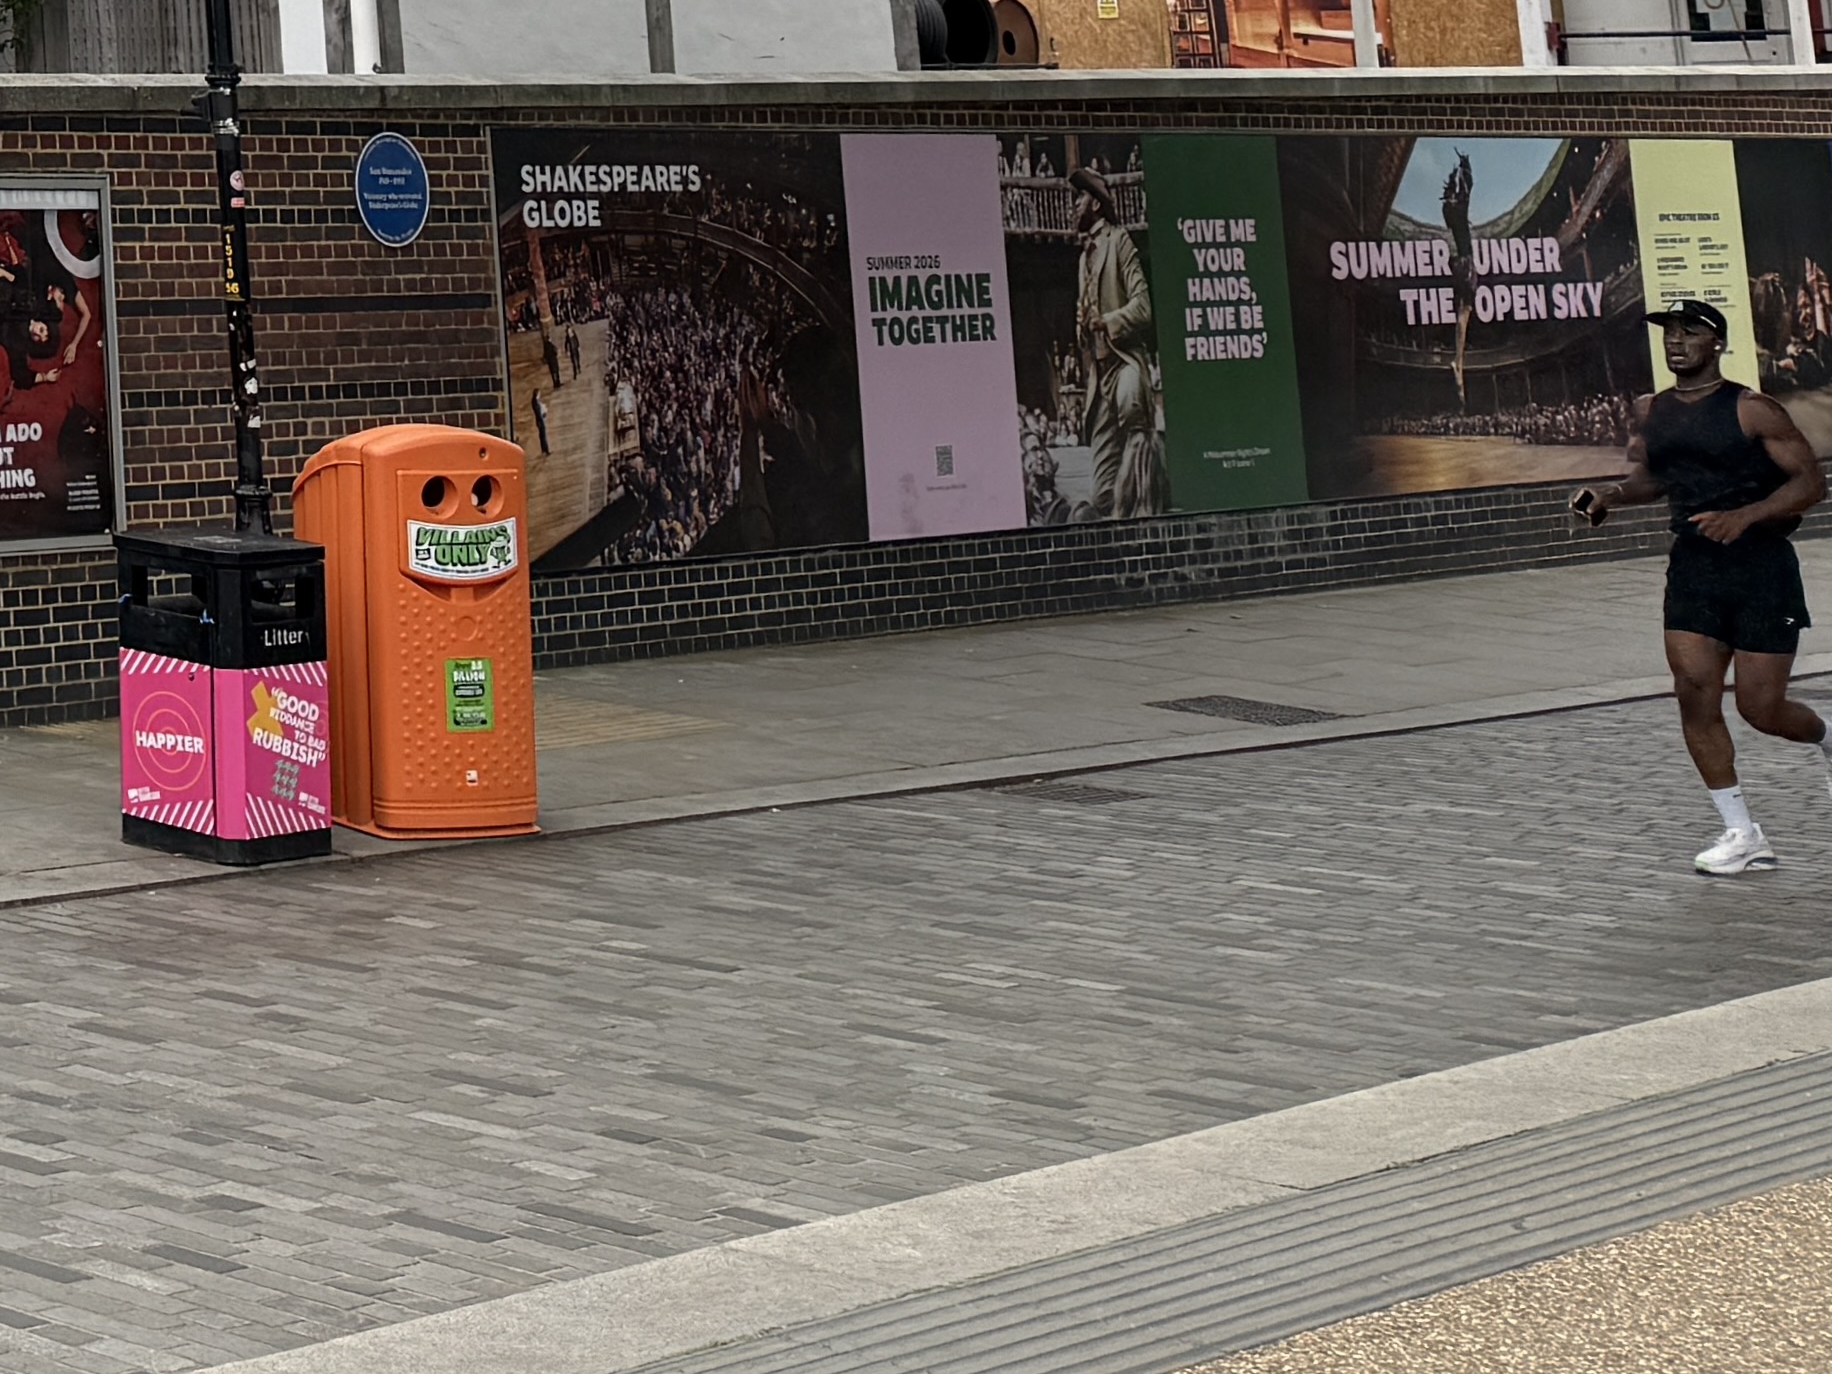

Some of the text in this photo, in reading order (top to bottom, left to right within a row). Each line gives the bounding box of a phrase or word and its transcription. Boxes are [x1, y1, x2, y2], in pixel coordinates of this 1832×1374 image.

[520, 164, 701, 193] SHAKESPEARE'S
[523, 200, 601, 228] GLOBE
[1177, 217, 1256, 243] 'GIVE ME
[866, 255, 941, 271] SUMMER 2026
[1192, 247, 1246, 272] YOUR
[1329, 237, 1562, 280] SUMMER UNDER
[868, 273, 992, 313] IMAGINE
[1187, 277, 1257, 305] HANDS,
[1399, 282, 1603, 325] THE OPEN SKY
[872, 313, 997, 346] TOGETHER
[1185, 305, 1264, 331] IF WE BE
[1185, 331, 1268, 361] FRIENDS'
[6, 422, 43, 443] ADO
[416, 525, 511, 546] VILLAINS
[435, 543, 491, 567] ONLY
[264, 629, 303, 647] Litter
[271, 686, 320, 721] "GOOD
[135, 730, 205, 754] HAPPIER
[253, 728, 326, 768] RUBBISH"
[294, 730, 326, 751] TO BAD
